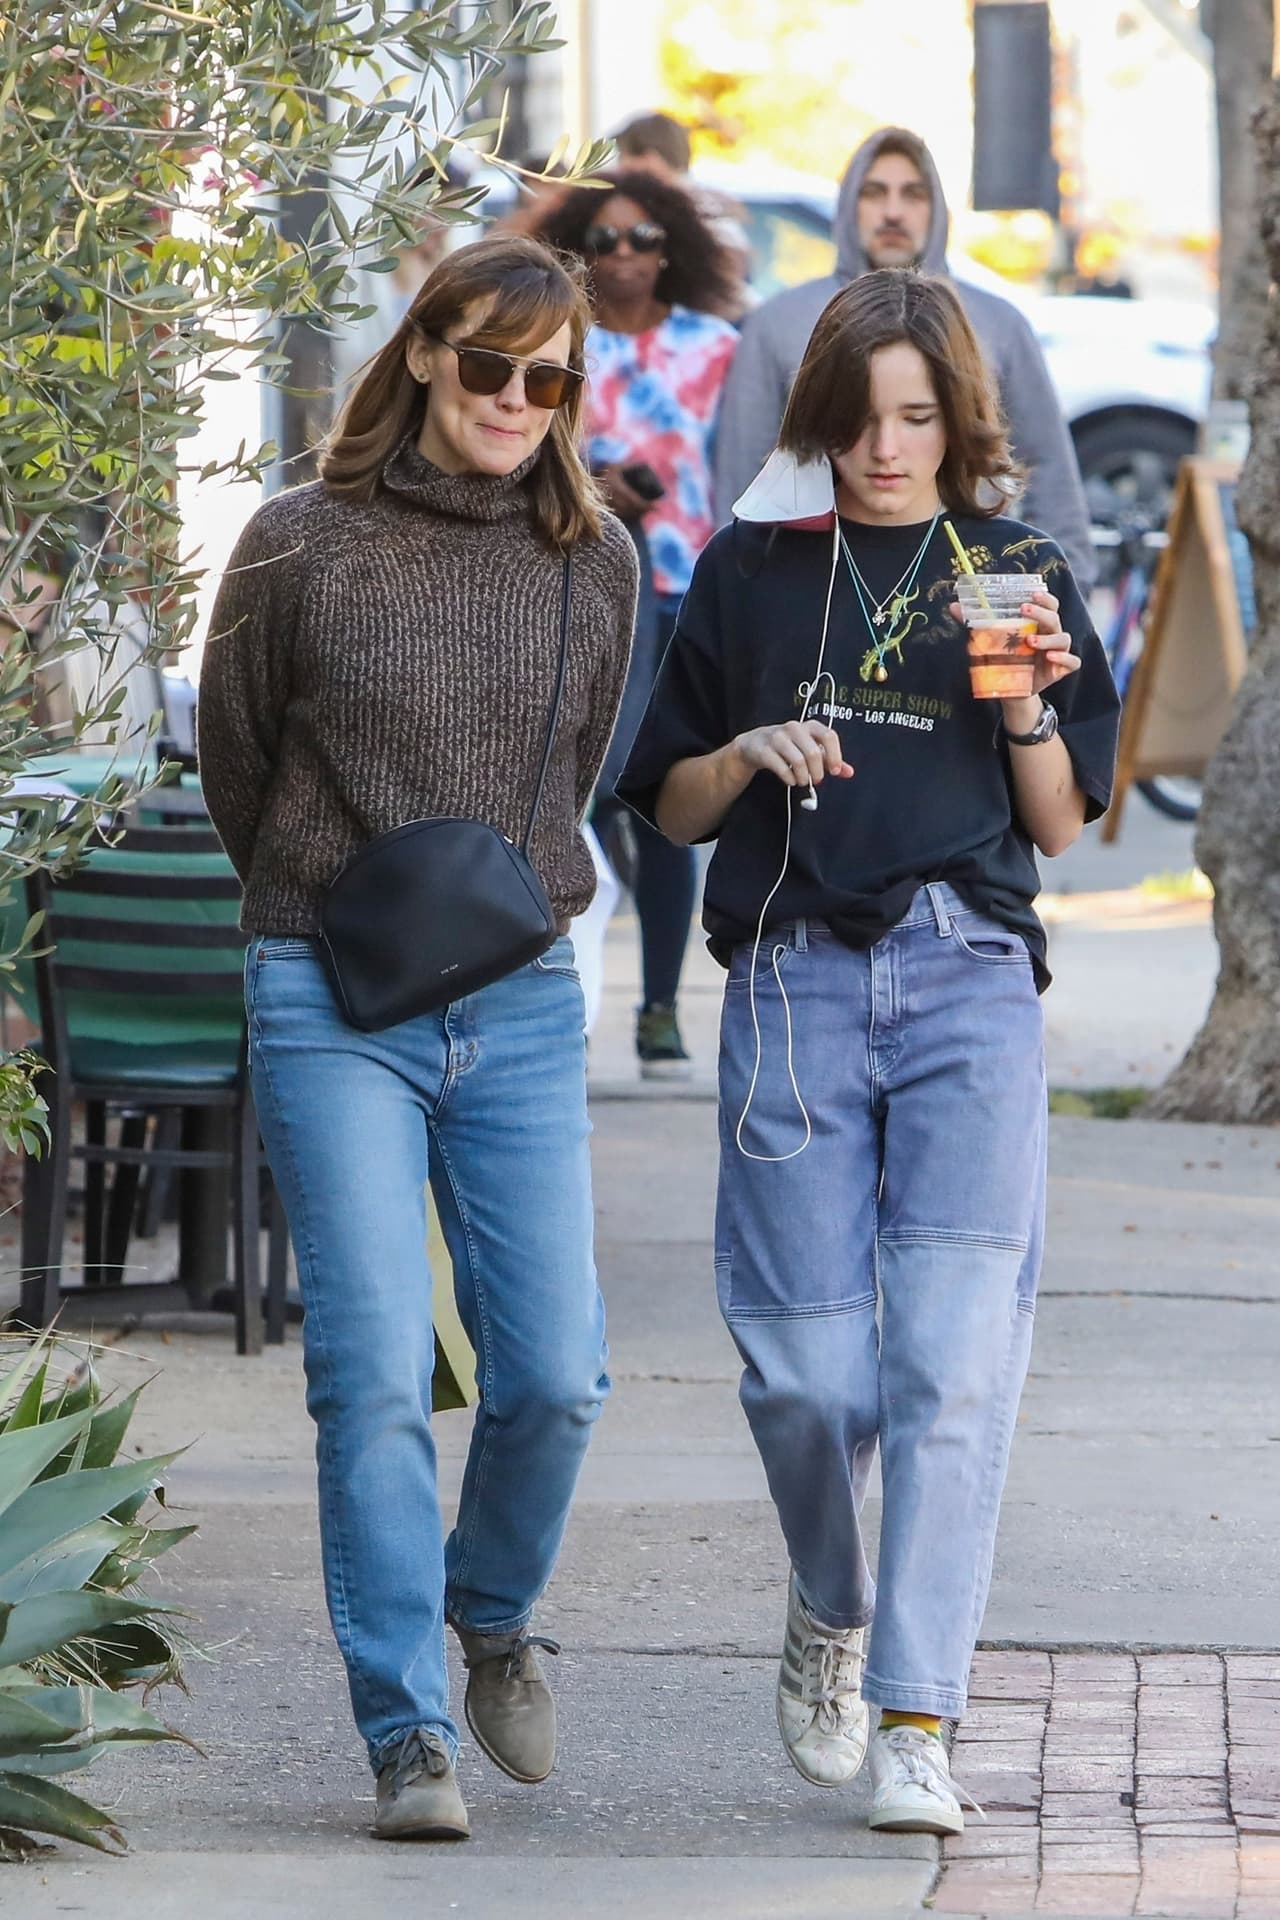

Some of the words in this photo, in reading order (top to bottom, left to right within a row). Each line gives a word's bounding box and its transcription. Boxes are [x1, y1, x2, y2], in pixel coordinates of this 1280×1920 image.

[852, 687, 902, 708] SUPER
[907, 693, 953, 720] SHOW
[864, 709, 886, 724] LOS
[886, 711, 935, 732] ANGELES
